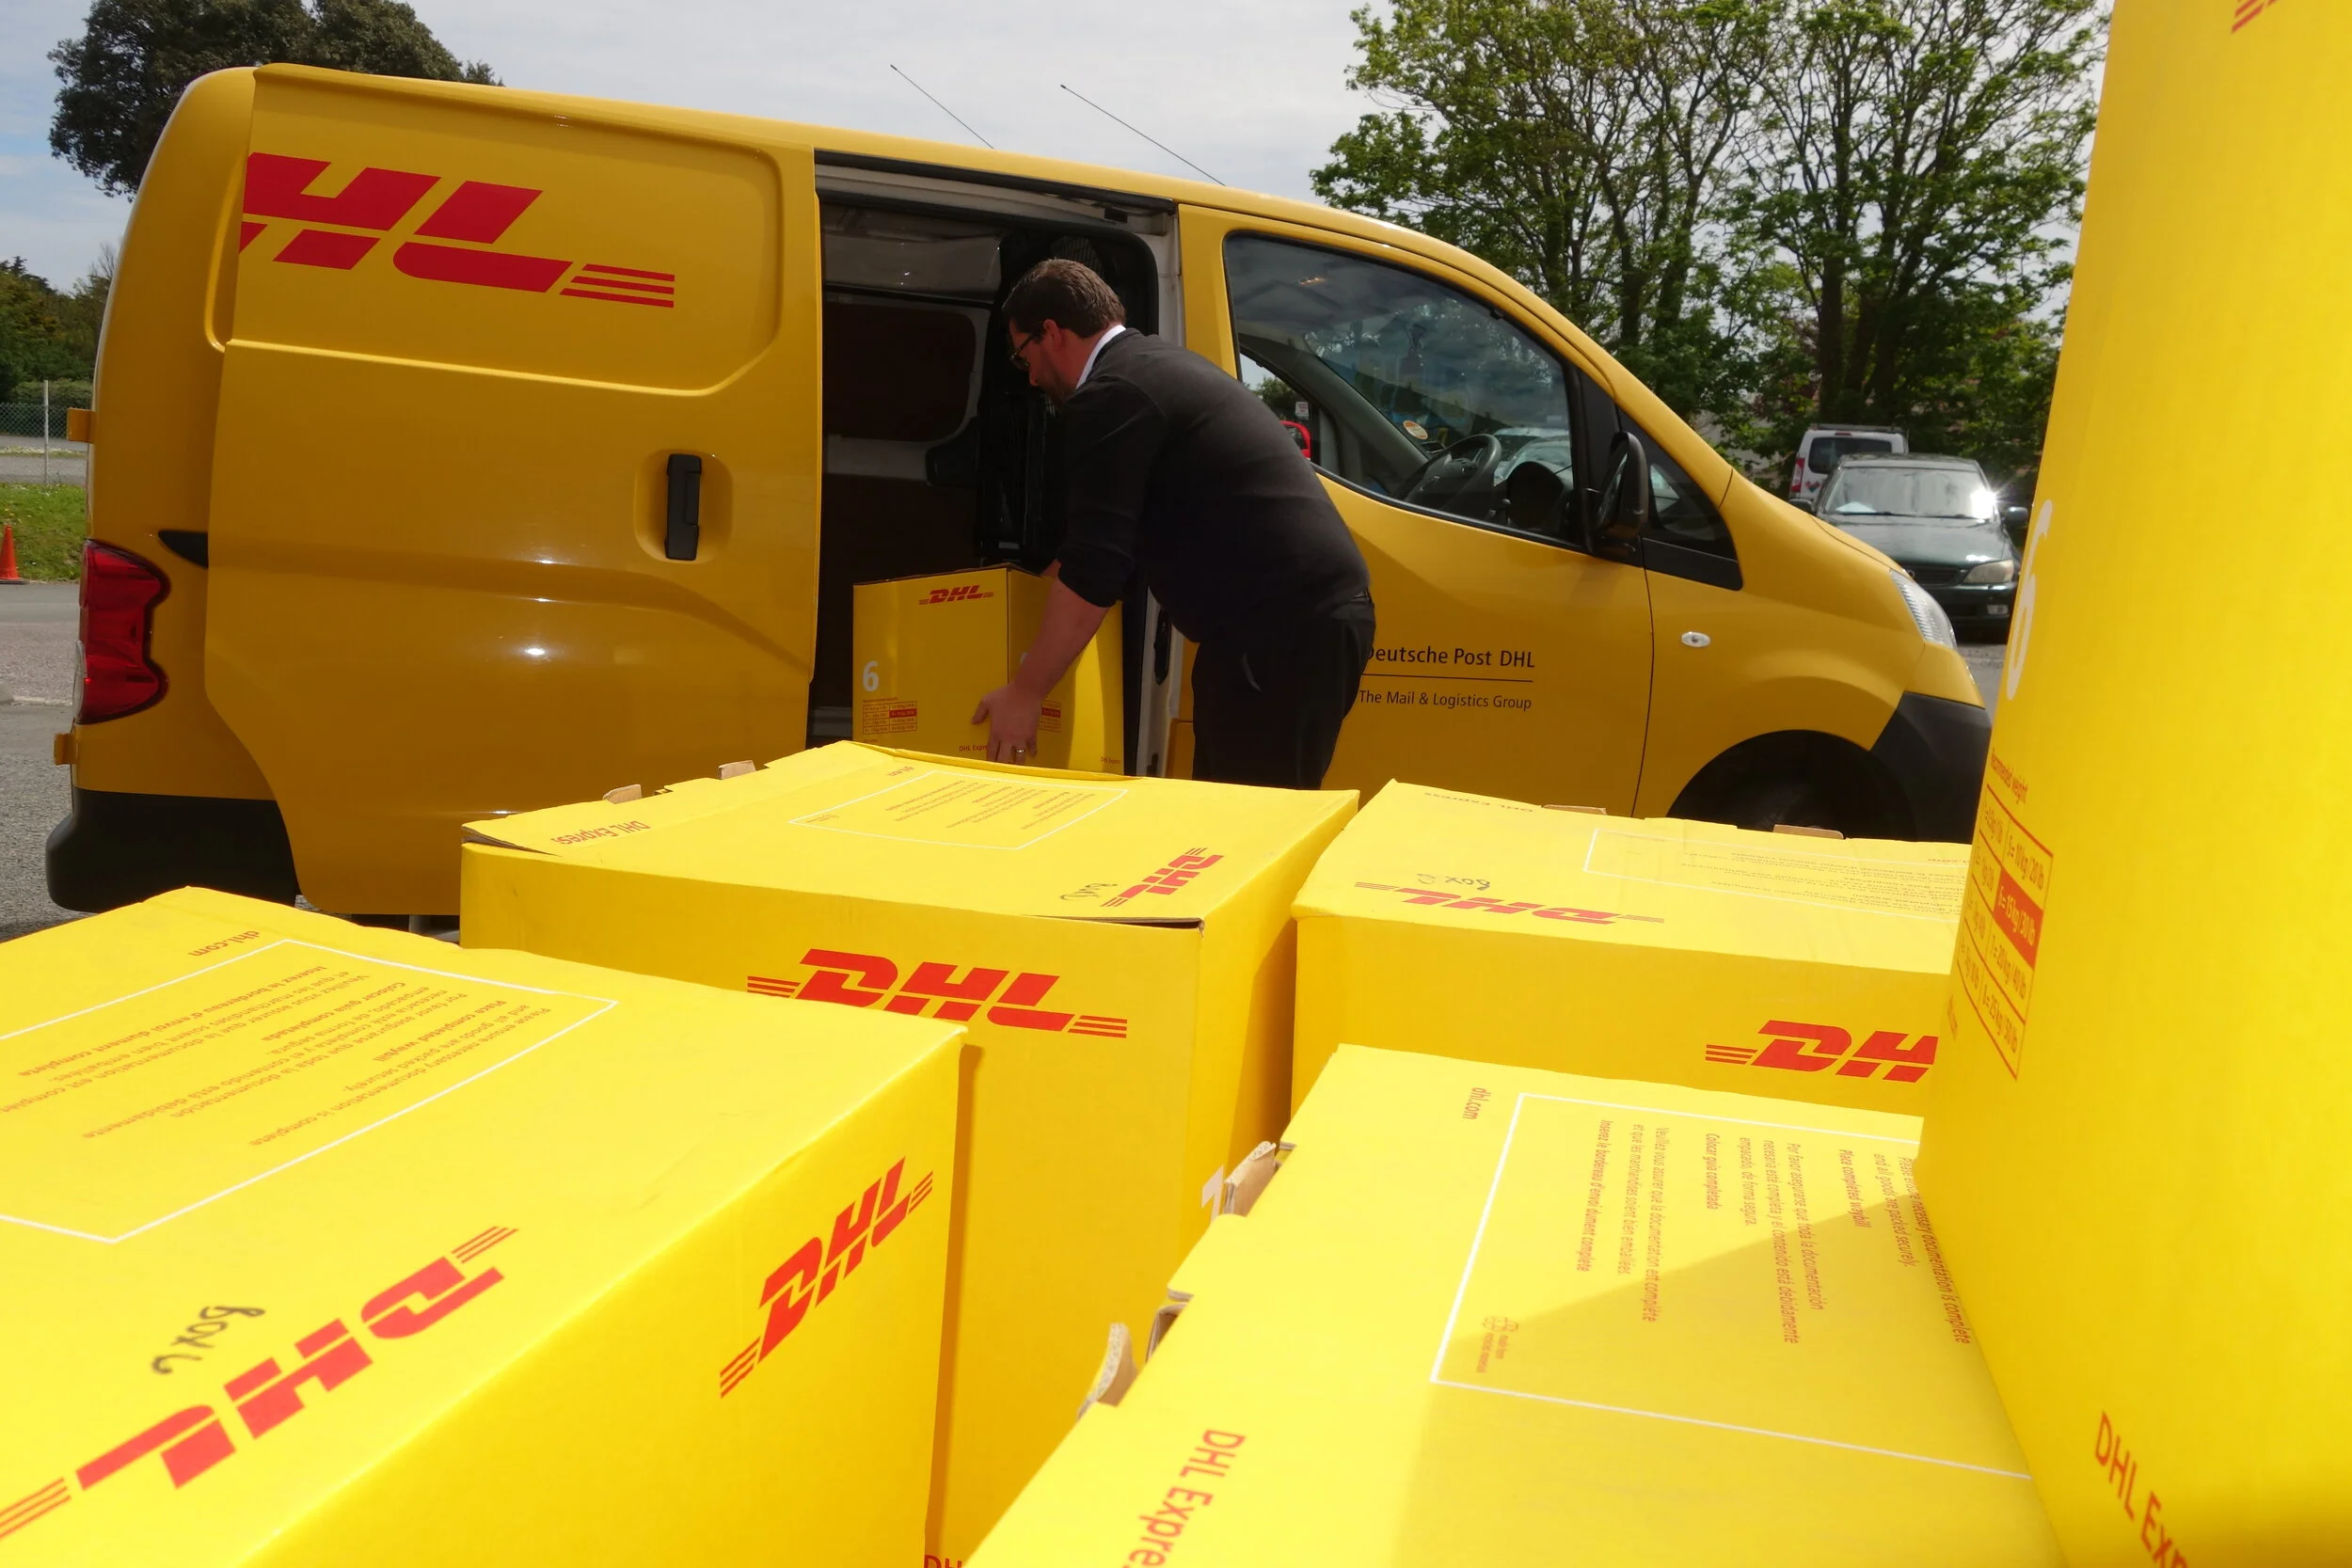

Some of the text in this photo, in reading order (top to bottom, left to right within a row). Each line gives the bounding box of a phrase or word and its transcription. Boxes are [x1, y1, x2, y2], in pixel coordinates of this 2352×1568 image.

[929, 585, 984, 605] DHL
[2007, 499, 2053, 701] 6
[1454, 648, 1492, 666] Post
[1500, 650, 1535, 669] DHL
[862, 660, 880, 692] 6
[1359, 689, 1533, 712] The Mail & Logistics Group
[549, 820, 651, 846] DHL Express
[1118, 854, 1225, 900] DHL
[1395, 887, 1621, 926] DHL
[187, 928, 261, 958] dhl.com
[782, 947, 1073, 1032] DHL
[1461, 1086, 1493, 1120] dhl.com
[1597, 1118, 1613, 1142] Inserez
[1629, 1131, 1643, 1144] que
[1631, 1123, 1645, 1132] et
[1654, 1127, 1670, 1151] Veuillez
[1629, 1143, 1645, 1153] les
[1652, 1150, 1665, 1166] vous
[1705, 1132, 1721, 1156] Colocar
[1762, 1139, 1779, 1168] necesaria
[1786, 1142, 1802, 1154] Por
[1591, 1148, 1610, 1181] bordereau
[1625, 1153, 1642, 1196] marchandises
[1651, 1165, 1664, 1190] assurer
[1788, 1154, 1804, 1172] favor
[1703, 1171, 1722, 1210] completada
[1737, 1136, 1757, 1226] empacado, de forma segura.
[1787, 1171, 1806, 1207] asegurarse
[1837, 1148, 1871, 1227] Place completed waybill
[1623, 1196, 1640, 1218] soient
[1647, 1189, 1663, 1204] que
[1649, 1203, 1666, 1212] la
[1765, 1183, 1784, 1214] completa
[1872, 1152, 1919, 1267] and all goods are packed securely.
[1581, 1207, 1601, 1236] dument
[1621, 1218, 1638, 1235] bien
[1770, 1220, 1786, 1228] el
[1791, 1207, 1809, 1221] que
[1904, 1198, 1936, 1235] necessary
[1646, 1212, 1665, 1267] documentation
[1797, 1222, 1816, 1240] toda
[1800, 1240, 1818, 1248] la
[757, 1157, 911, 1363] DHL
[1575, 1236, 1595, 1272] complete
[1772, 1228, 1791, 1267] contenido
[1645, 1268, 1661, 1282] est
[1918, 1232, 1957, 1295] documentation
[1939, 1291, 1962, 1304] is
[1778, 1286, 1800, 1343] debidamente
[1936, 1300, 1978, 1347] complete
[74, 1256, 505, 1490] DHL
[2094, 1410, 2137, 1523] DHL
[1120, 1429, 1247, 1568] DHL Expre
